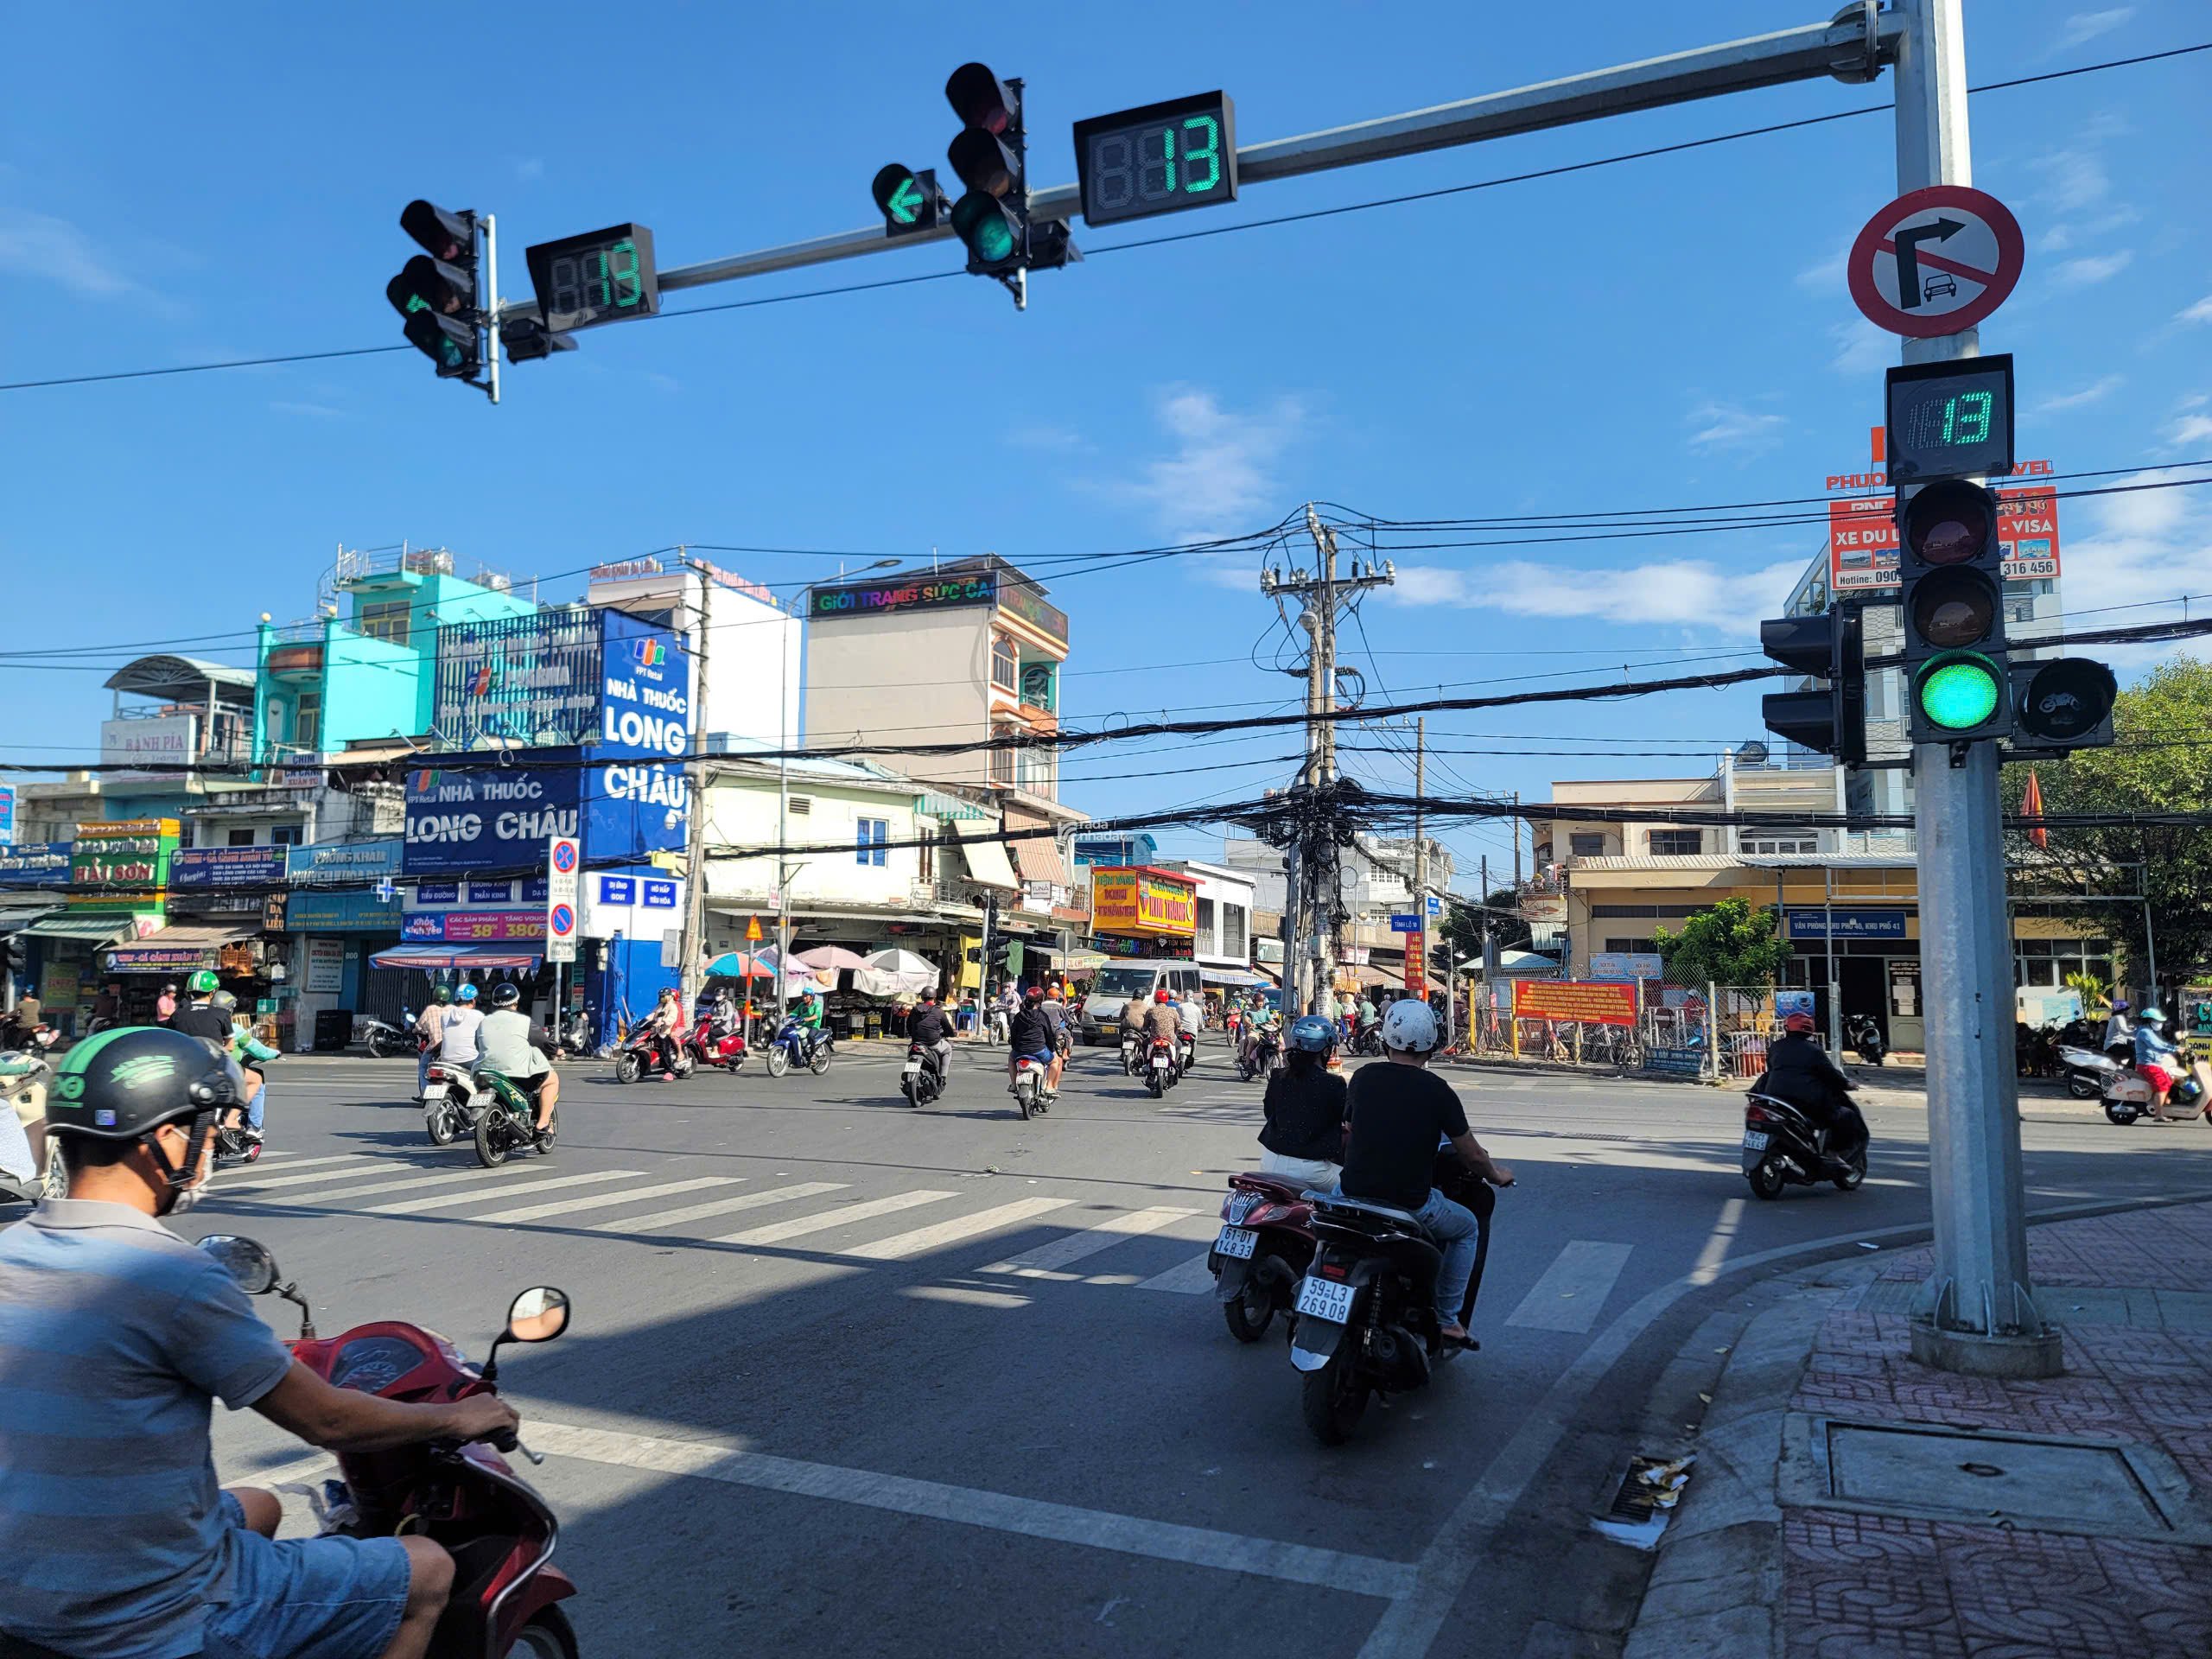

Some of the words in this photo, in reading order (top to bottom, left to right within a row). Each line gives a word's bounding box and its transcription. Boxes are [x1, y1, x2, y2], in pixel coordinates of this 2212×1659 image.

[1162, 114, 1219, 194] 13
[601, 239, 642, 308] 13
[1942, 391, 1993, 445] 13
[1835, 531, 1858, 546] XE
[1863, 529, 1887, 543] DU
[2012, 518, 2054, 534] VISA
[1840, 575, 1872, 586] Hotline:
[2004, 562, 2026, 575] 316
[2030, 561, 2053, 574] 456
[504, 666, 570, 690] PHARMA
[636, 665, 646, 677] FPT
[607, 677, 637, 702] NHÀ
[642, 688, 687, 715] THUỐC
[606, 706, 686, 756] LONG
[291, 753, 315, 765] CHIM
[439, 778, 474, 803] NHÀ
[483, 772, 543, 800] THUỐC
[605, 763, 686, 809] CHÂU
[406, 813, 482, 843] LONG
[495, 804, 578, 840] CHÂU
[1807, 921, 1827, 930] PHÒNG
[1879, 920, 1891, 930] PHỐ
[1217, 1240, 1252, 1257] 148.33
[1224, 1228, 1252, 1244] 61-D1
[1309, 1279, 1348, 1303] 59-L3
[1300, 1295, 1347, 1321] 269.08
